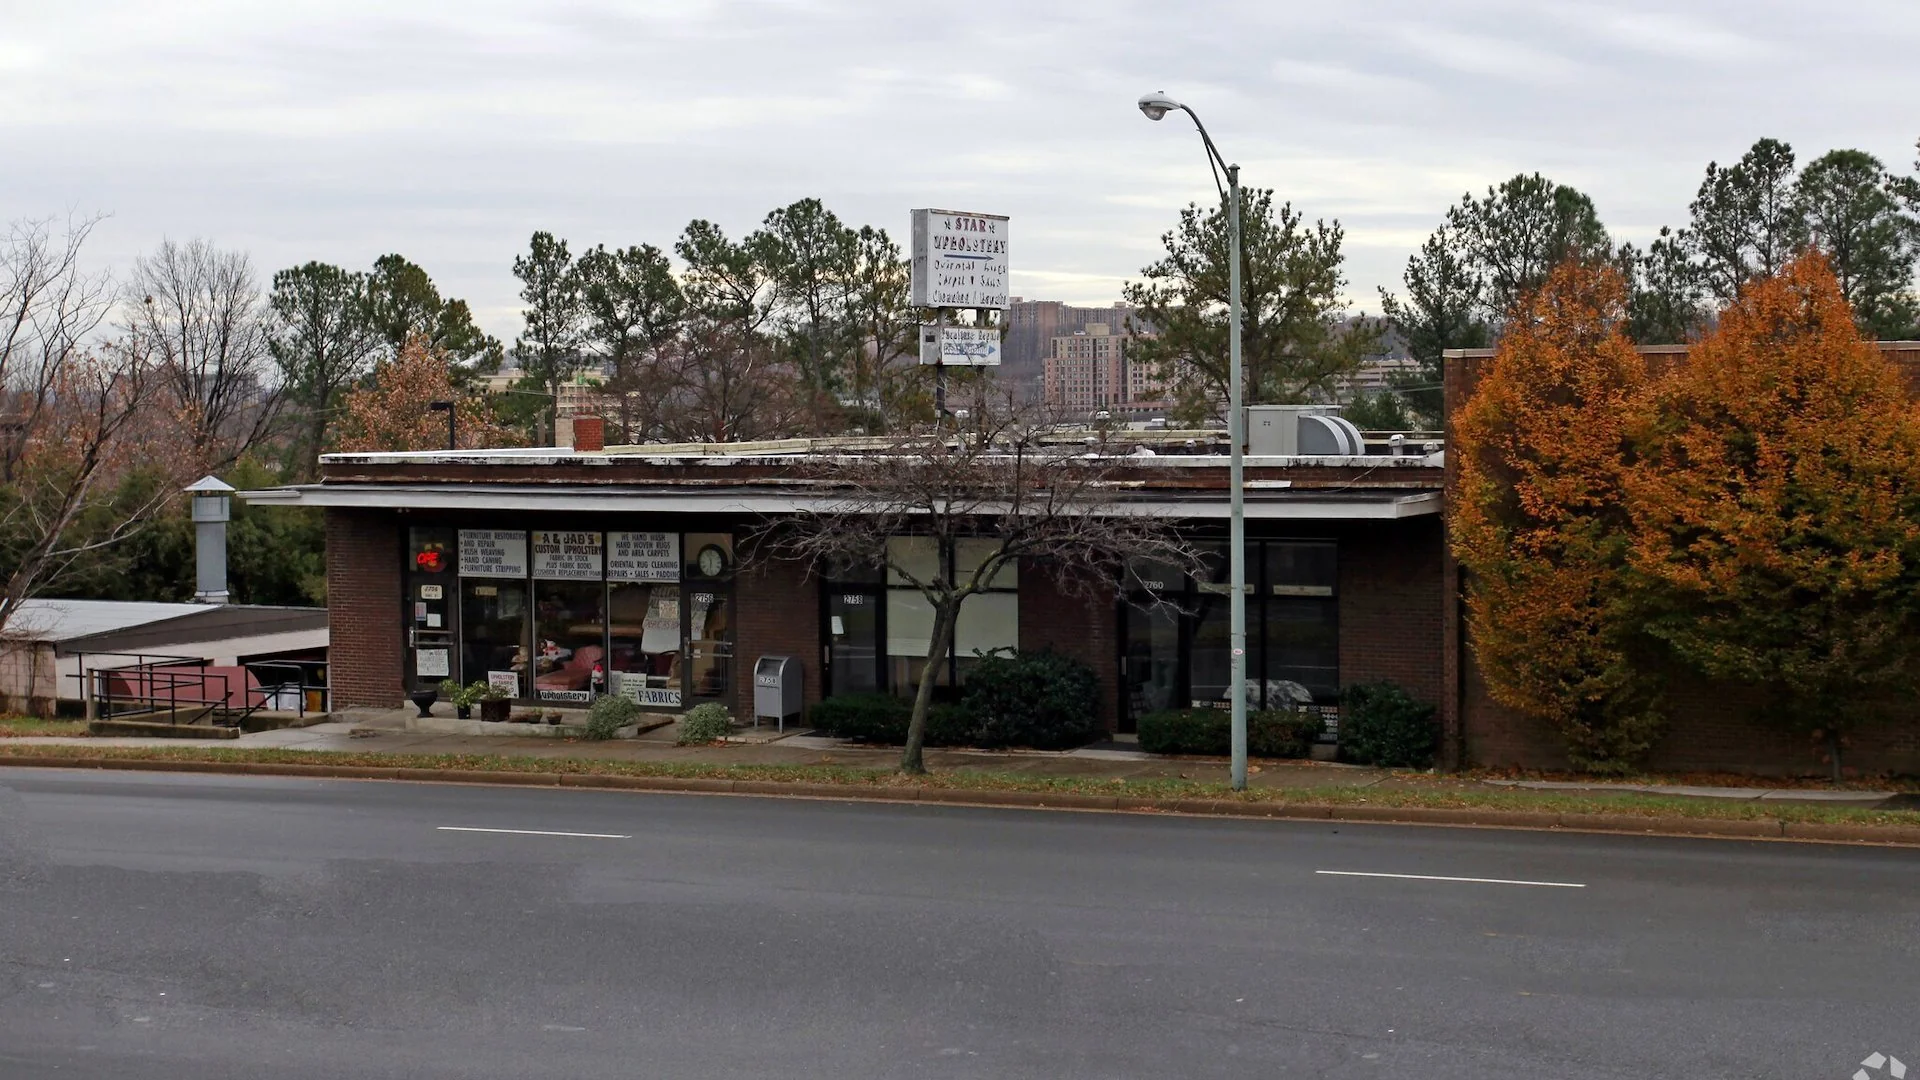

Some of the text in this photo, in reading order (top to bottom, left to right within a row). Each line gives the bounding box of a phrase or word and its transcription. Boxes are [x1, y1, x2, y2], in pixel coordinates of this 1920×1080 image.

[955, 217, 986, 232] STAR
[543, 533, 550, 544] A
[553, 533, 560, 544] &
[535, 545, 602, 555] CUSTOM UPHOLSTERY
[464, 564, 521, 573] FURNITURE STRIPPING
[651, 561, 678, 569] CLEANING
[1144, 581, 1164, 590] 2760
[638, 690, 681, 703] FABRICS
